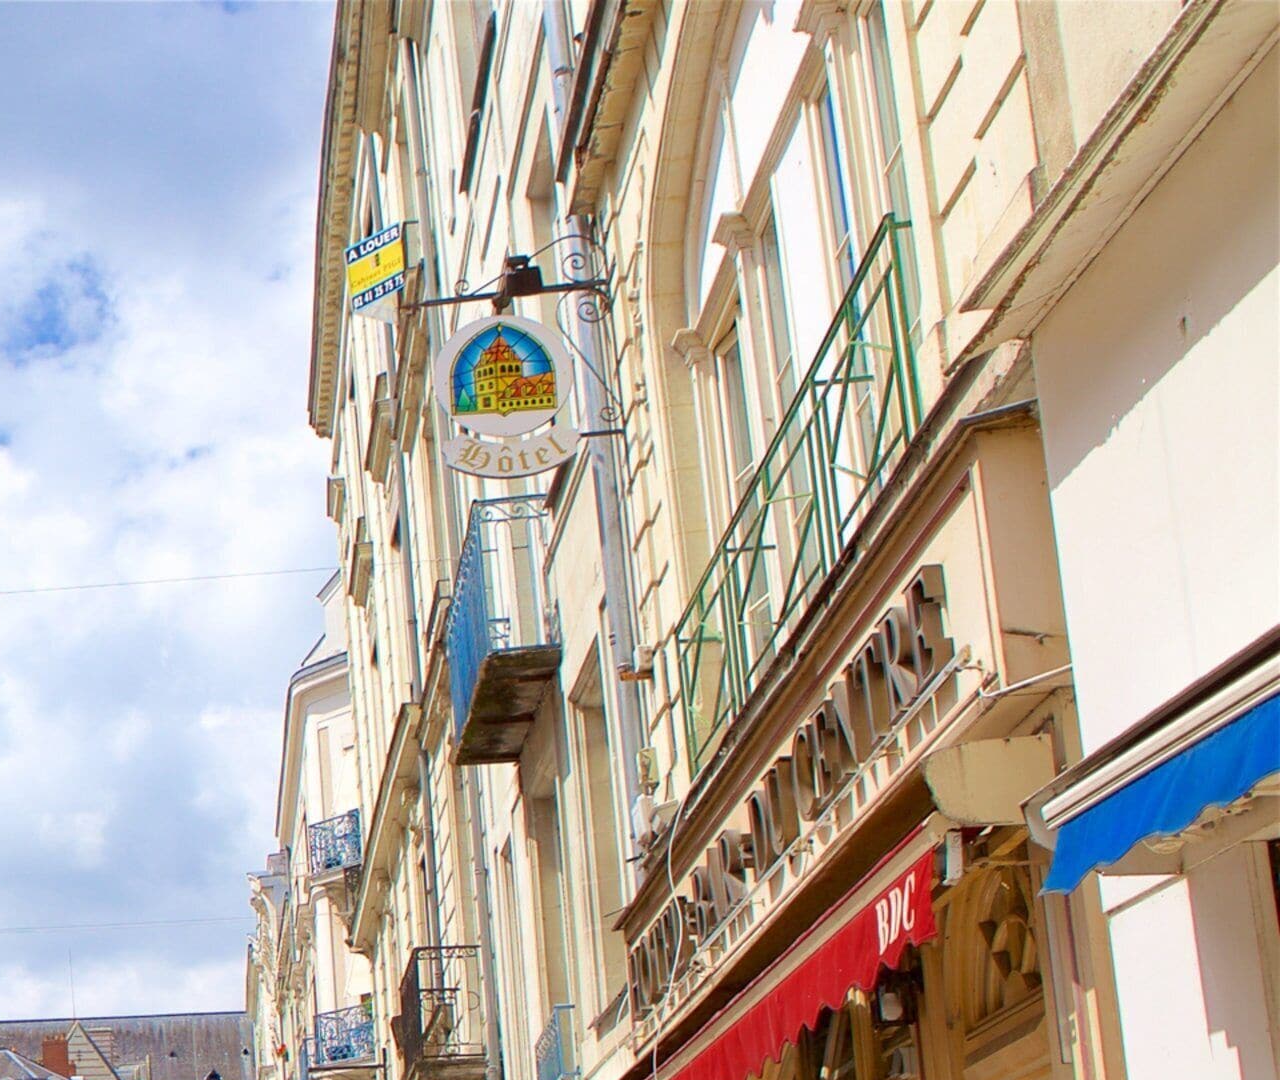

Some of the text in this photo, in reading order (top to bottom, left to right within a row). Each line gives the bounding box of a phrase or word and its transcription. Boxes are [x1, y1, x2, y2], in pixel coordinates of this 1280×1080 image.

[348, 227, 399, 262] A LOUER
[364, 292, 373, 302] 41
[455, 436, 567, 472] Hôtel
[791, 563, 957, 822] CENTRE
[875, 868, 916, 956] BDC
